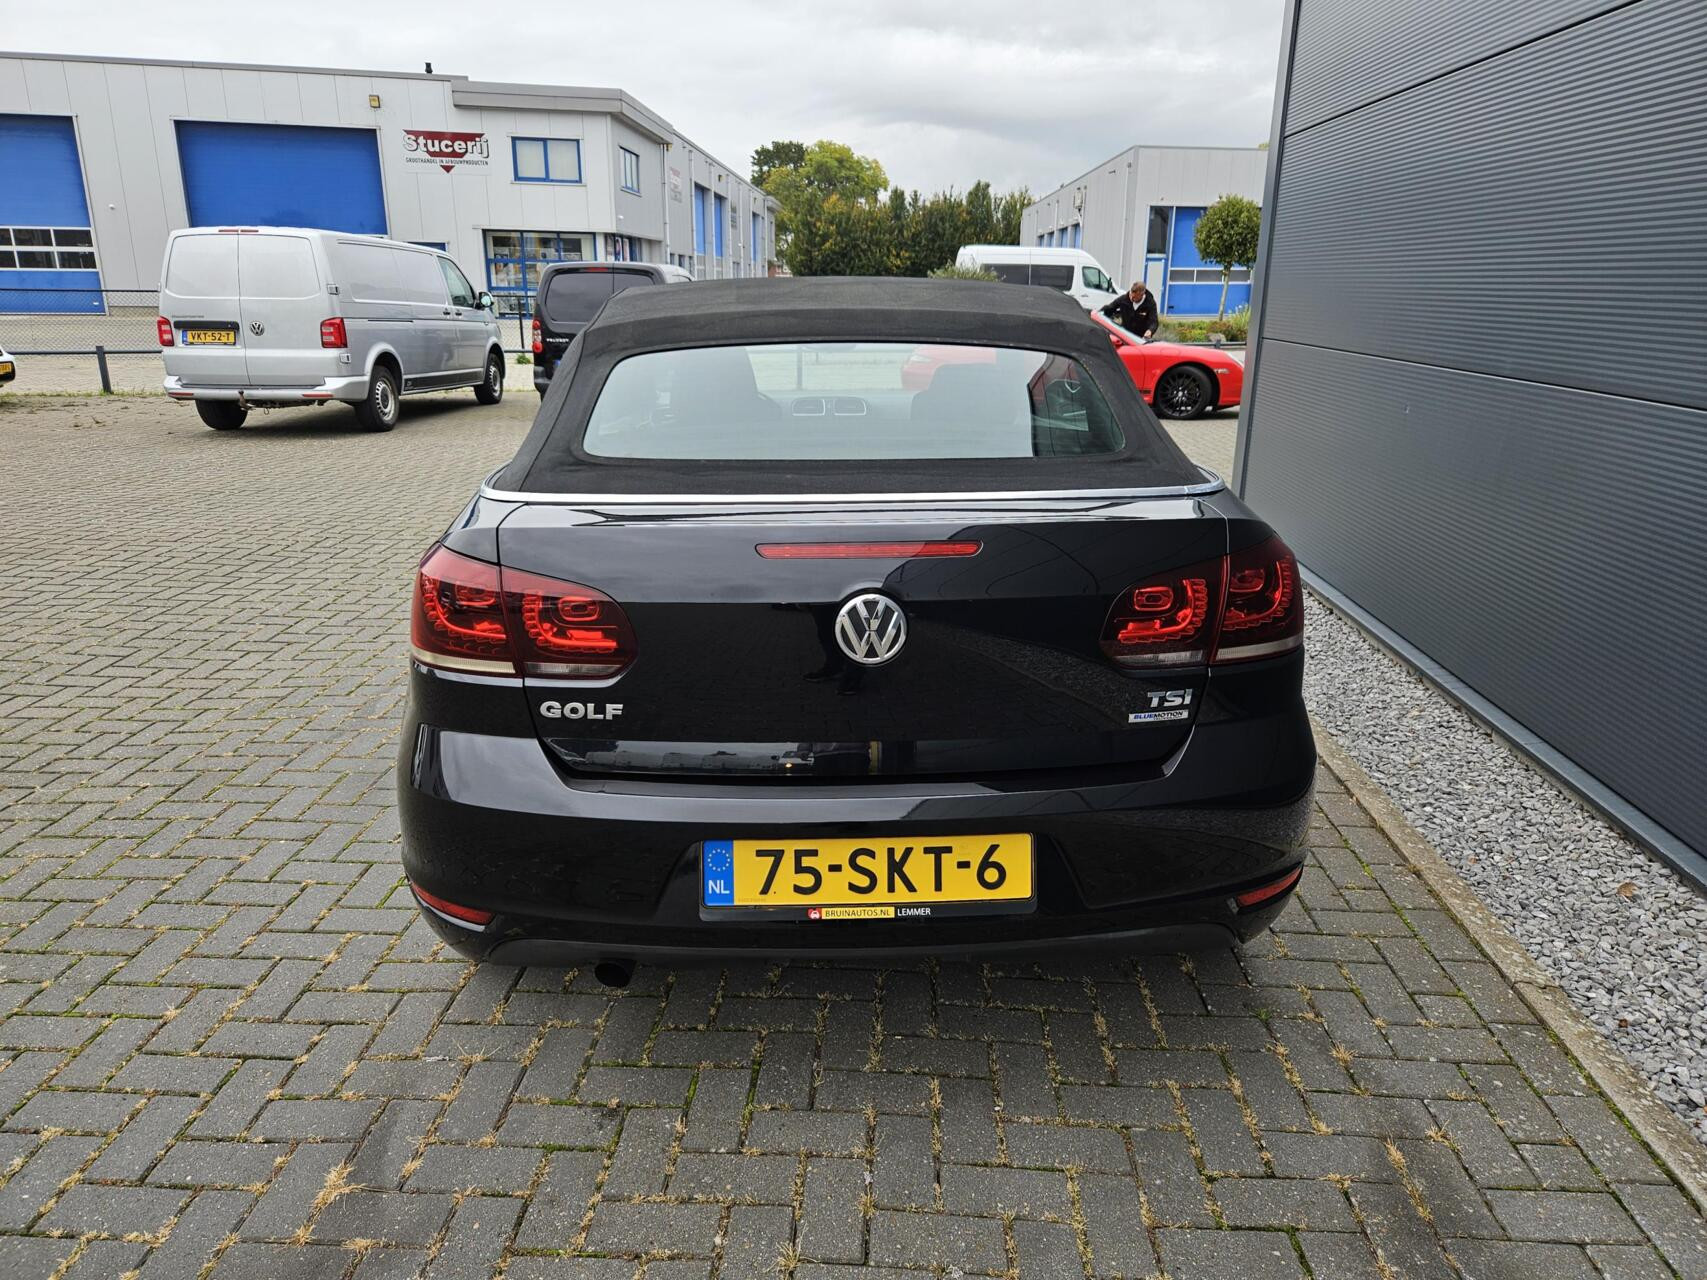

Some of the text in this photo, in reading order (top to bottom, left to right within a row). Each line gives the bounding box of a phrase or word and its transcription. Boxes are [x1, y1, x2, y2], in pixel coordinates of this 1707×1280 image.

[403, 135, 490, 158] Stucerij
[191, 332, 231, 341] VKT-52-T
[1147, 688, 1193, 708] TSI
[539, 700, 624, 720] GOLF
[1134, 711, 1184, 719] BLUEMOTION
[754, 843, 1007, 896] 75-SKT-6
[708, 879, 730, 894] NL
[825, 907, 931, 918] BRUINAUTOS.NL LEMMER
